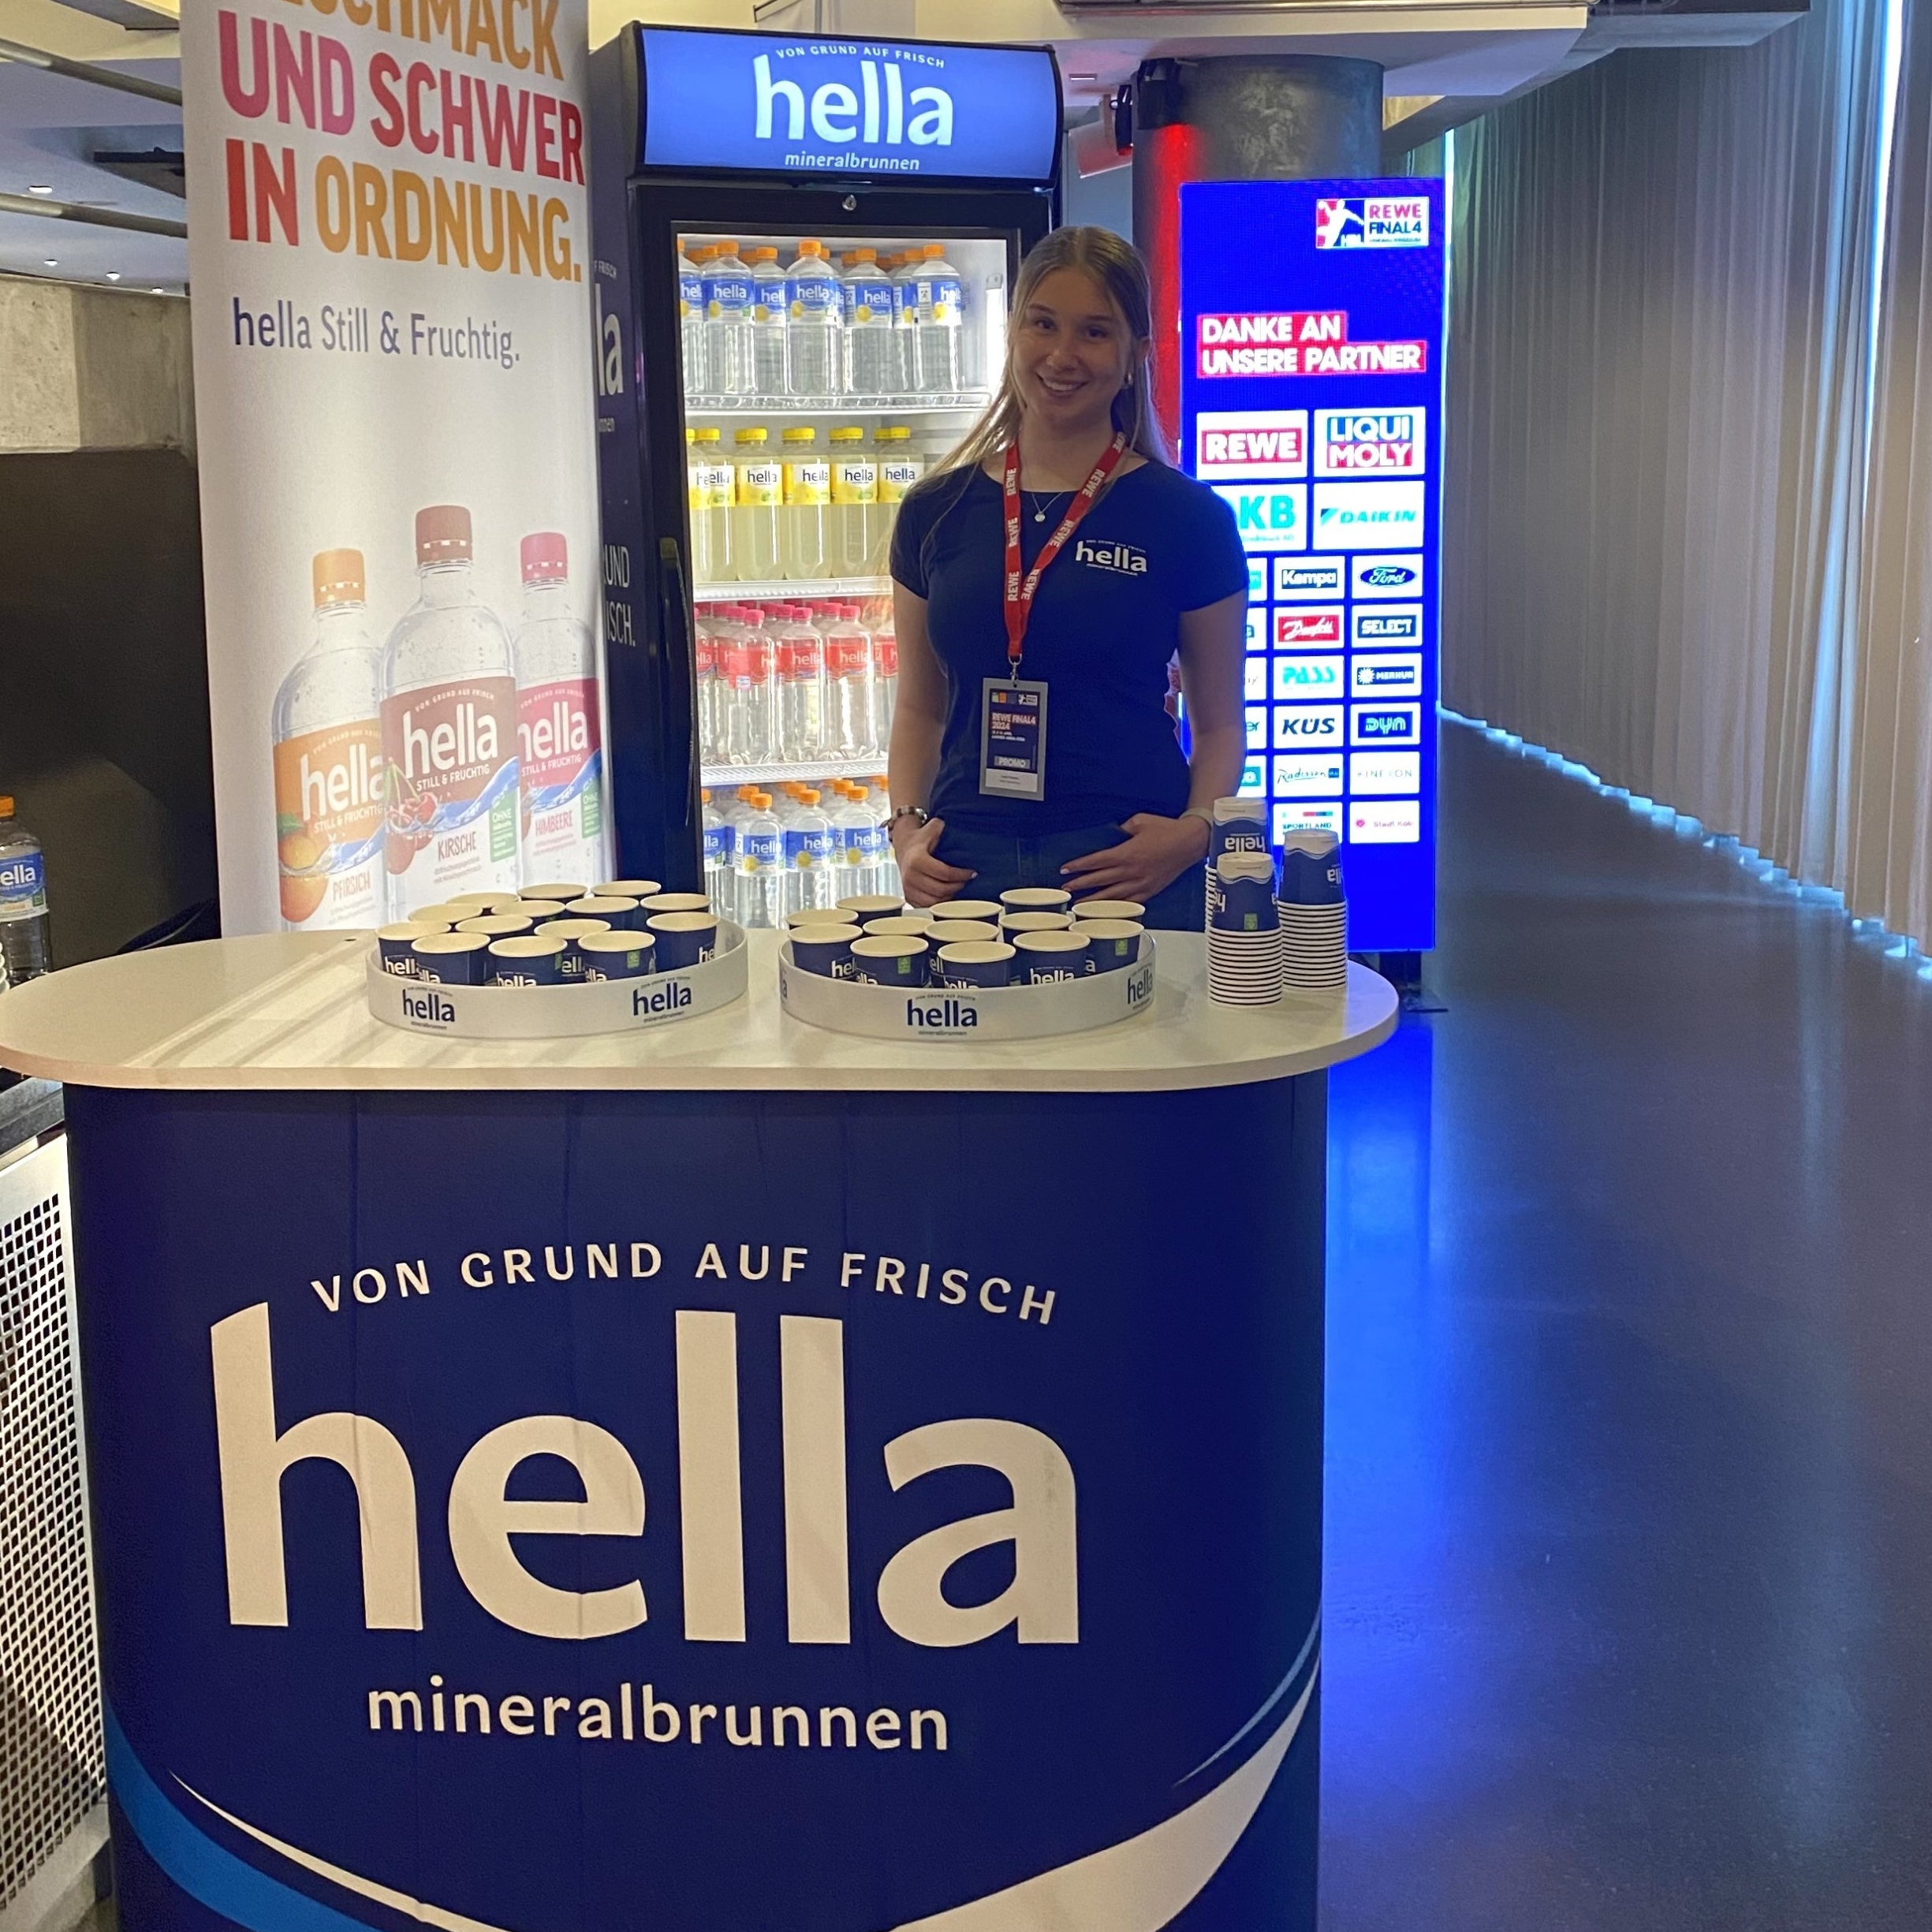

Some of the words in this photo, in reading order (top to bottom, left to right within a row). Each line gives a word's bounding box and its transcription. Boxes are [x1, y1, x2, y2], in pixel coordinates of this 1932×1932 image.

[776, 47, 805, 59] VON
[811, 45, 857, 55] GRUND
[863, 47, 889, 58] AUF
[896, 50, 945, 69] FRISCH
[218, 10, 355, 136] UND
[369, 52, 585, 185] SCHWER
[753, 54, 953, 146] hella
[785, 151, 919, 170] mineralbrunnen
[226, 139, 300, 247] IN
[315, 155, 582, 283] ORDNUNG.
[1369, 203, 1422, 219] REWE
[714, 284, 747, 299] hella
[761, 289, 785, 304] hell
[796, 284, 829, 299] hella
[864, 289, 891, 304] hella
[233, 297, 311, 349] hella
[321, 304, 369, 354] Still
[380, 310, 401, 355] &
[411, 312, 520, 370] Fruchtig.
[1202, 316, 1292, 343] DANKE
[1300, 315, 1341, 341] AN
[1202, 348, 1298, 374] UNSERE
[1305, 344, 1421, 371] PARTNER
[1330, 415, 1412, 442] LIQUI
[1205, 431, 1299, 461] REWE
[1329, 442, 1412, 468] MOLY
[710, 471, 730, 483] ell
[845, 468, 873, 481] hella
[886, 467, 915, 480] hella
[1006, 467, 1017, 497] REWE
[1082, 468, 1106, 498] REWE
[1227, 494, 1296, 531] KB
[1340, 509, 1416, 524] DAIKIN
[1050, 519, 1076, 547] REWE
[603, 544, 629, 587] UND
[1076, 540, 1147, 573] hella
[1008, 571, 1020, 602] REWE
[1021, 569, 1041, 600] REWE
[1368, 568, 1406, 585] Ford
[606, 600, 636, 647] ISCH.
[1361, 618, 1412, 635] SELECT
[1282, 666, 1337, 684] PASS
[402, 703, 498, 779] hella
[521, 765, 540, 777] STILL
[547, 754, 582, 768] FRUCHTIG
[998, 757, 1027, 767] PROMO
[416, 775, 440, 792] STILL
[442, 773, 447, 785] &
[449, 763, 490, 783] FRUCHTIG
[314, 815, 335, 834] STILL
[853, 831, 882, 846] hella
[437, 831, 477, 862] KIRSCHE
[751, 839, 782, 854] hella
[804, 836, 834, 850] hella
[0, 864, 36, 886] ella
[333, 870, 371, 901] PFIRSICH
[385, 956, 416, 975] hell
[831, 957, 856, 978] hel
[633, 982, 692, 1016] hella
[1128, 968, 1154, 1005] hella
[402, 988, 456, 1022] hella
[907, 998, 978, 1028] hella
[311, 1260, 431, 1313] VON
[460, 1243, 663, 1289] GRUND
[696, 1243, 809, 1283] AUF
[840, 1252, 1057, 1325] FRISCH
[211, 1302, 1080, 1647] hella
[367, 1674, 947, 1750] mineralbrunnen
